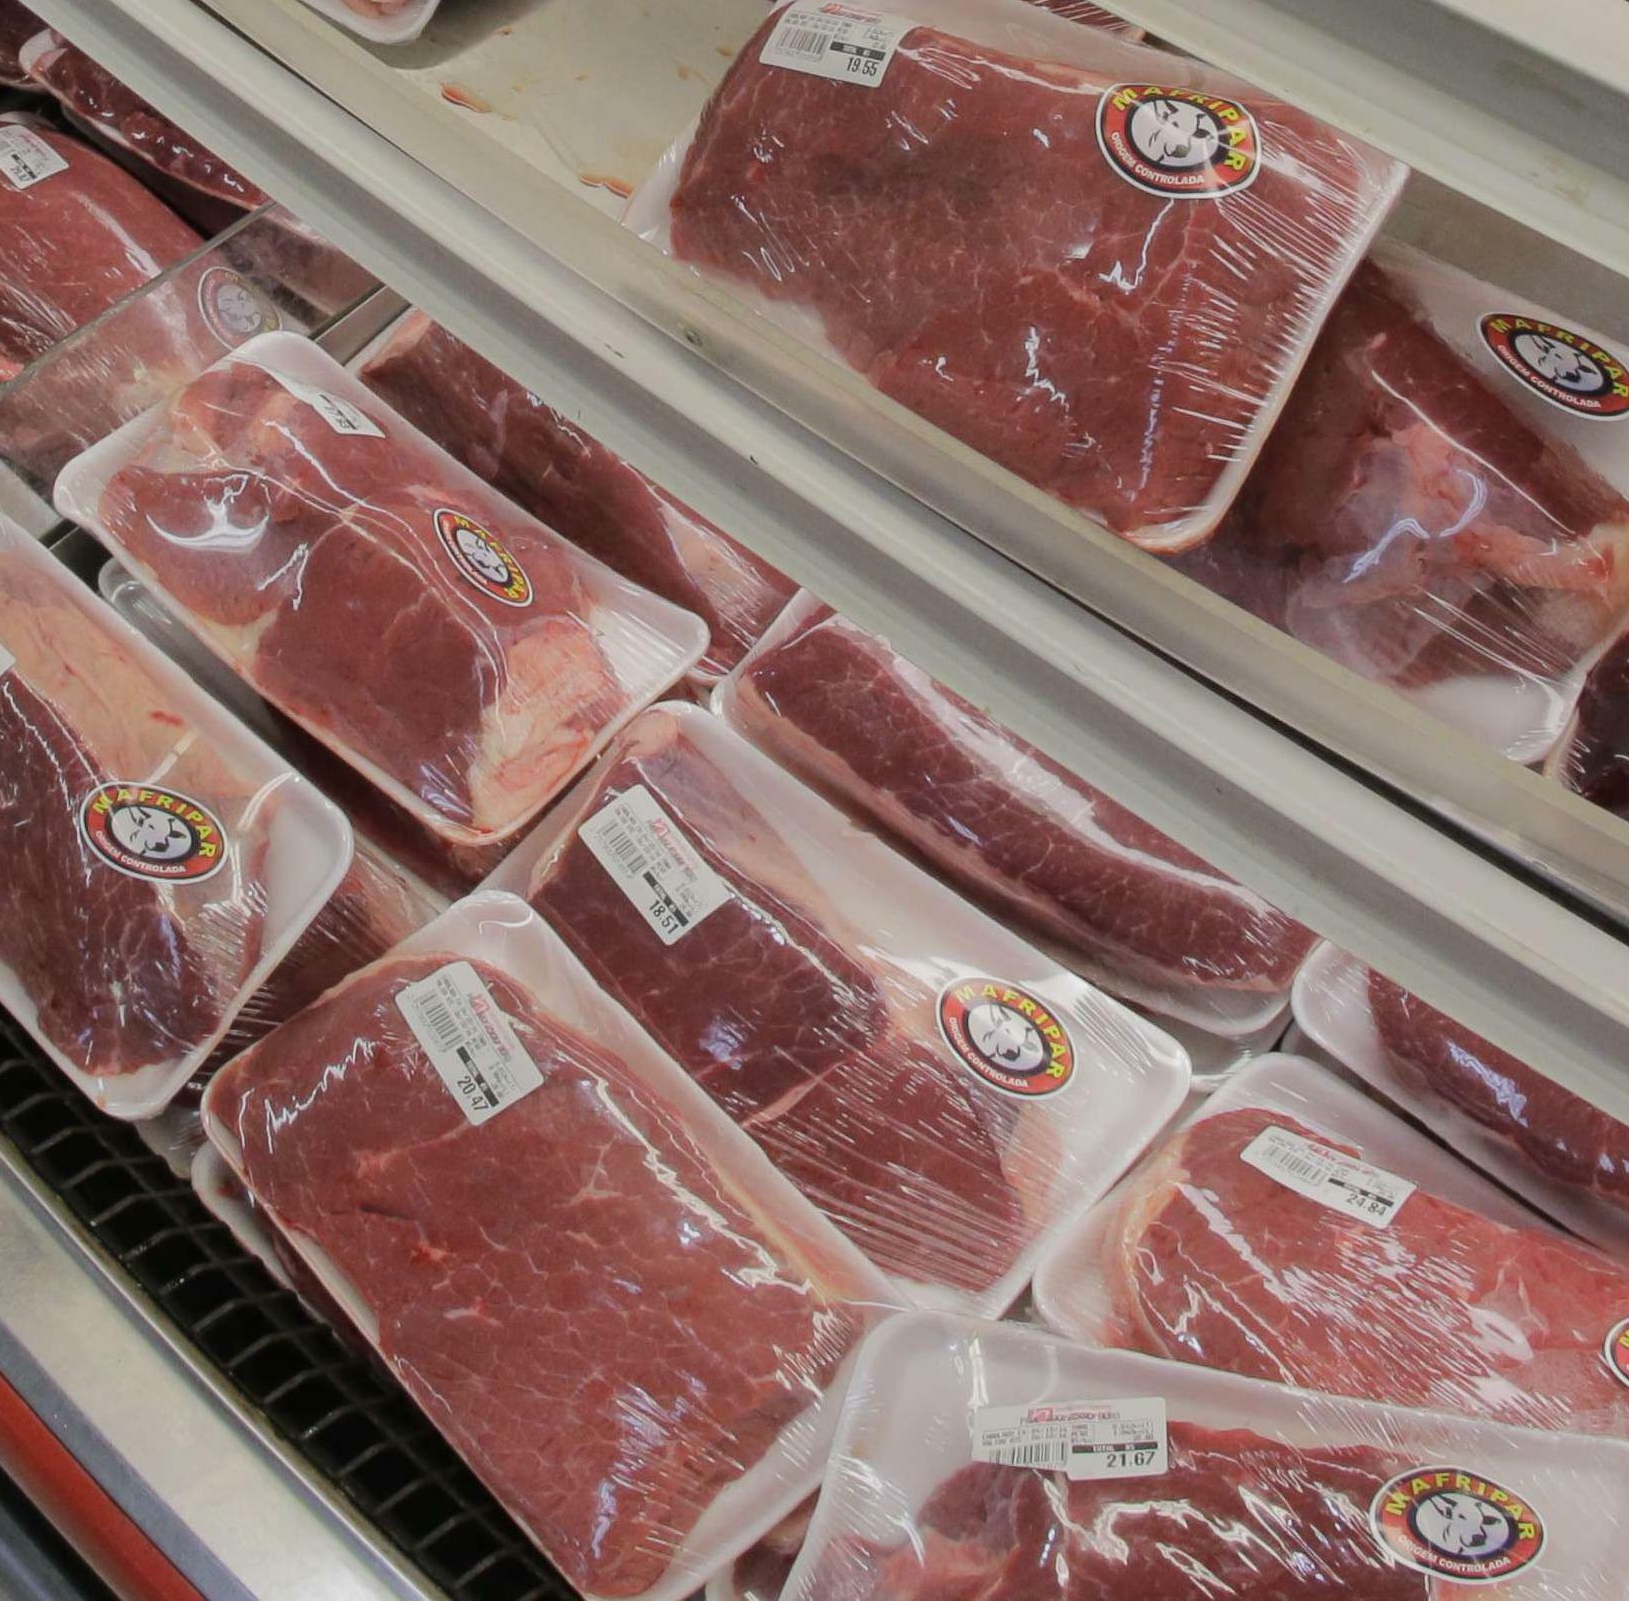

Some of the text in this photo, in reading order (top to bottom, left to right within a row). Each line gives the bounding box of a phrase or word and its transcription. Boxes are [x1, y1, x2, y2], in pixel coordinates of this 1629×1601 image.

[1111, 131, 1205, 185] ORIGEM CONTROLADA
[1490, 317, 1629, 399] MAFRIPAR
[1496, 343, 1602, 409] ORIGEM CONTROLADA
[92, 788, 217, 858] MAFRIPAR
[954, 985, 1067, 1080] MAFRIPAR
[969, 1052, 1030, 1088] CONTROLADA
[1386, 1471, 1536, 1540] MAFRIPAR
[1397, 1533, 1511, 1574] ORIGEM CONTROLADA
